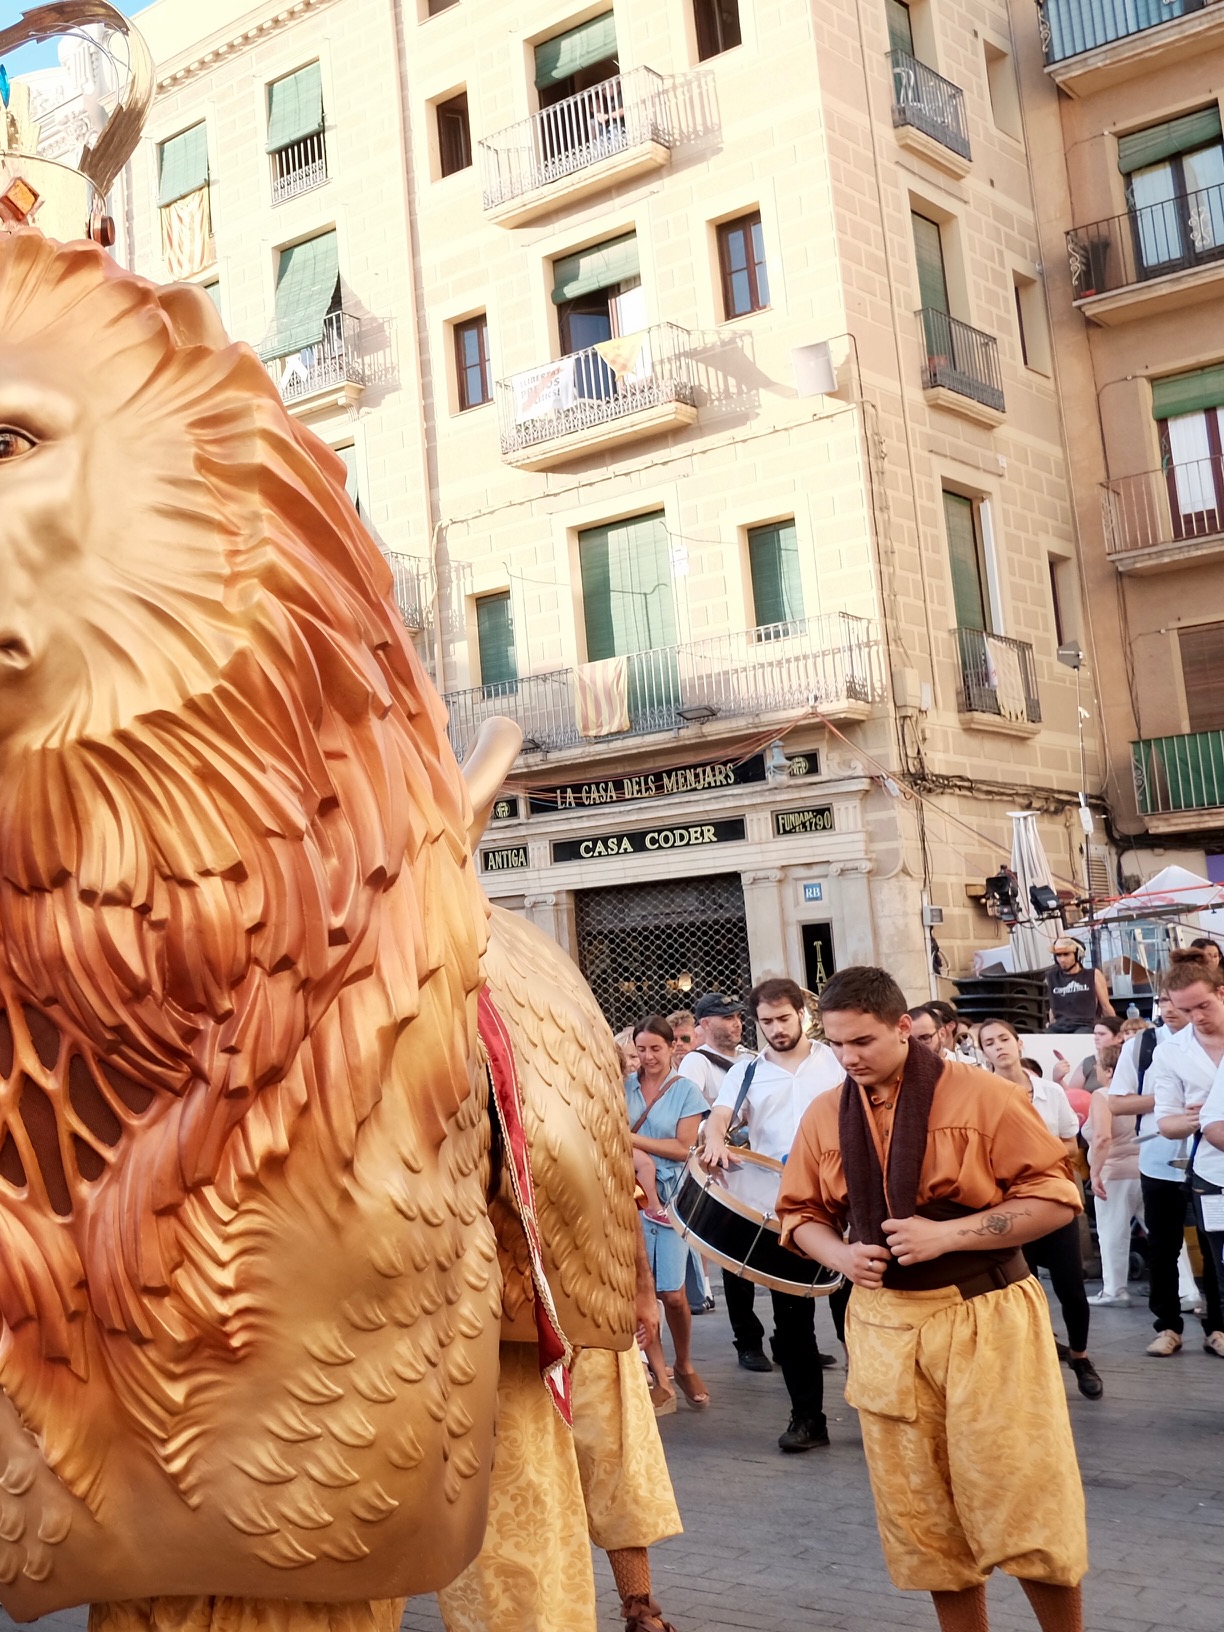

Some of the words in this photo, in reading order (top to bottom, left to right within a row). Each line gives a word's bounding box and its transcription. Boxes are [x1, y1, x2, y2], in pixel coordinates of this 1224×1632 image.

[557, 787, 576, 810] LA
[581, 781, 617, 806] CASA
[623, 775, 656, 799] DELS
[662, 763, 735, 794] MENJARS
[805, 810, 832, 831] 1790
[580, 836, 633, 858] CASA
[645, 825, 717, 850] CODER
[488, 848, 527, 870] ANTIGA
[805, 887, 821, 899] RB
